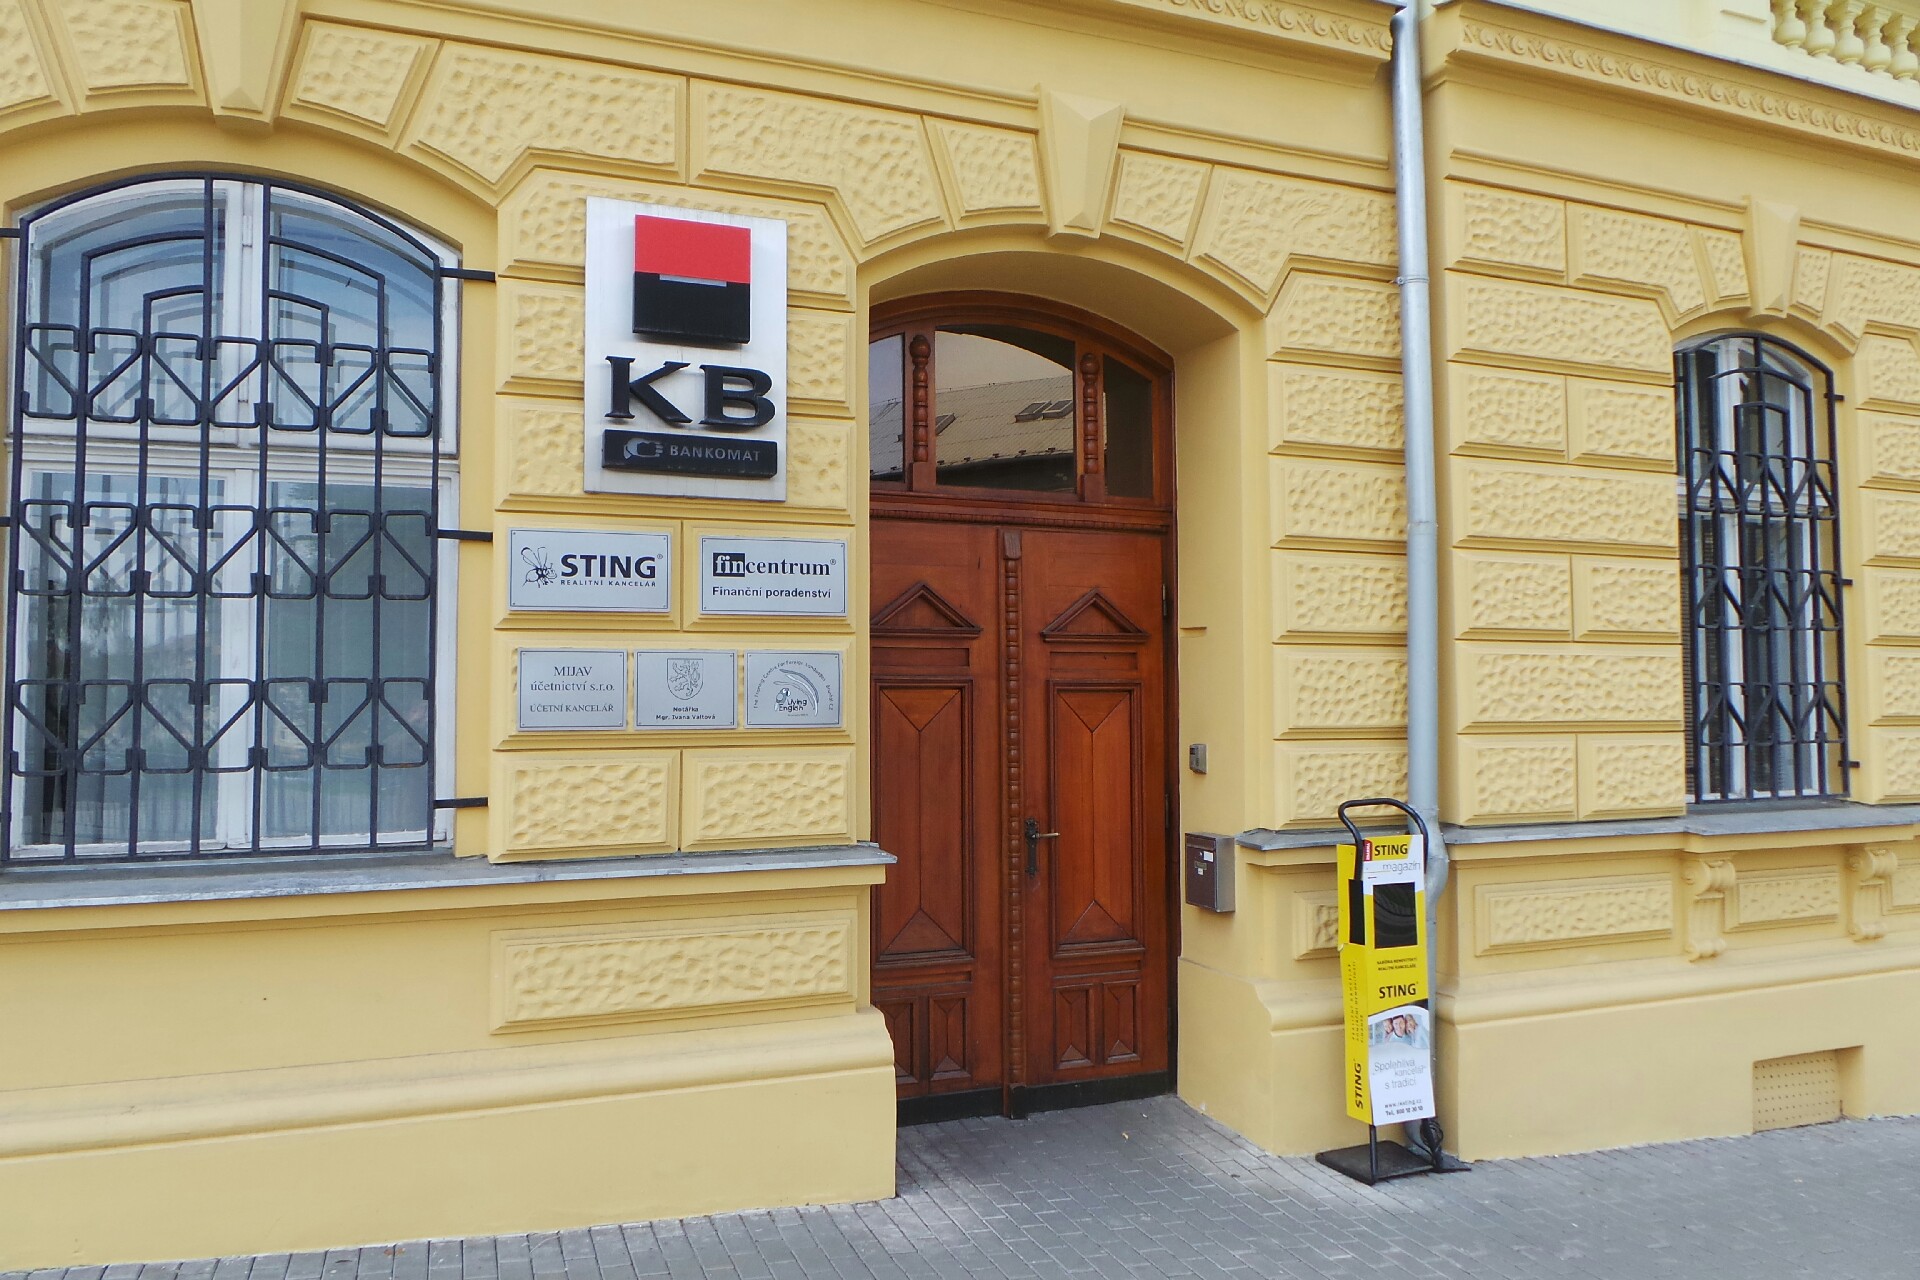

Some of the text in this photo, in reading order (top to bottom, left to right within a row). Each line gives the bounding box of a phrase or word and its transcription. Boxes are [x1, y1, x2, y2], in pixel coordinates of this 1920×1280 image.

[604, 355, 776, 427] KB
[669, 444, 761, 462] BANKOMAT
[561, 554, 656, 579] STING
[714, 554, 830, 576] fincentrum
[608, 580, 656, 588] KANCELÁŘ
[712, 586, 831, 599] Finanční poradenství
[553, 666, 593, 677] MIJAV
[530, 680, 615, 692] účetnictví s.r.o.
[529, 703, 614, 713] ÚČETNÍ KANCELÁŘ
[778, 703, 804, 713] English
[1374, 843, 1408, 856] STING
[1378, 983, 1416, 999] STING
[1353, 1063, 1364, 1109] STING
